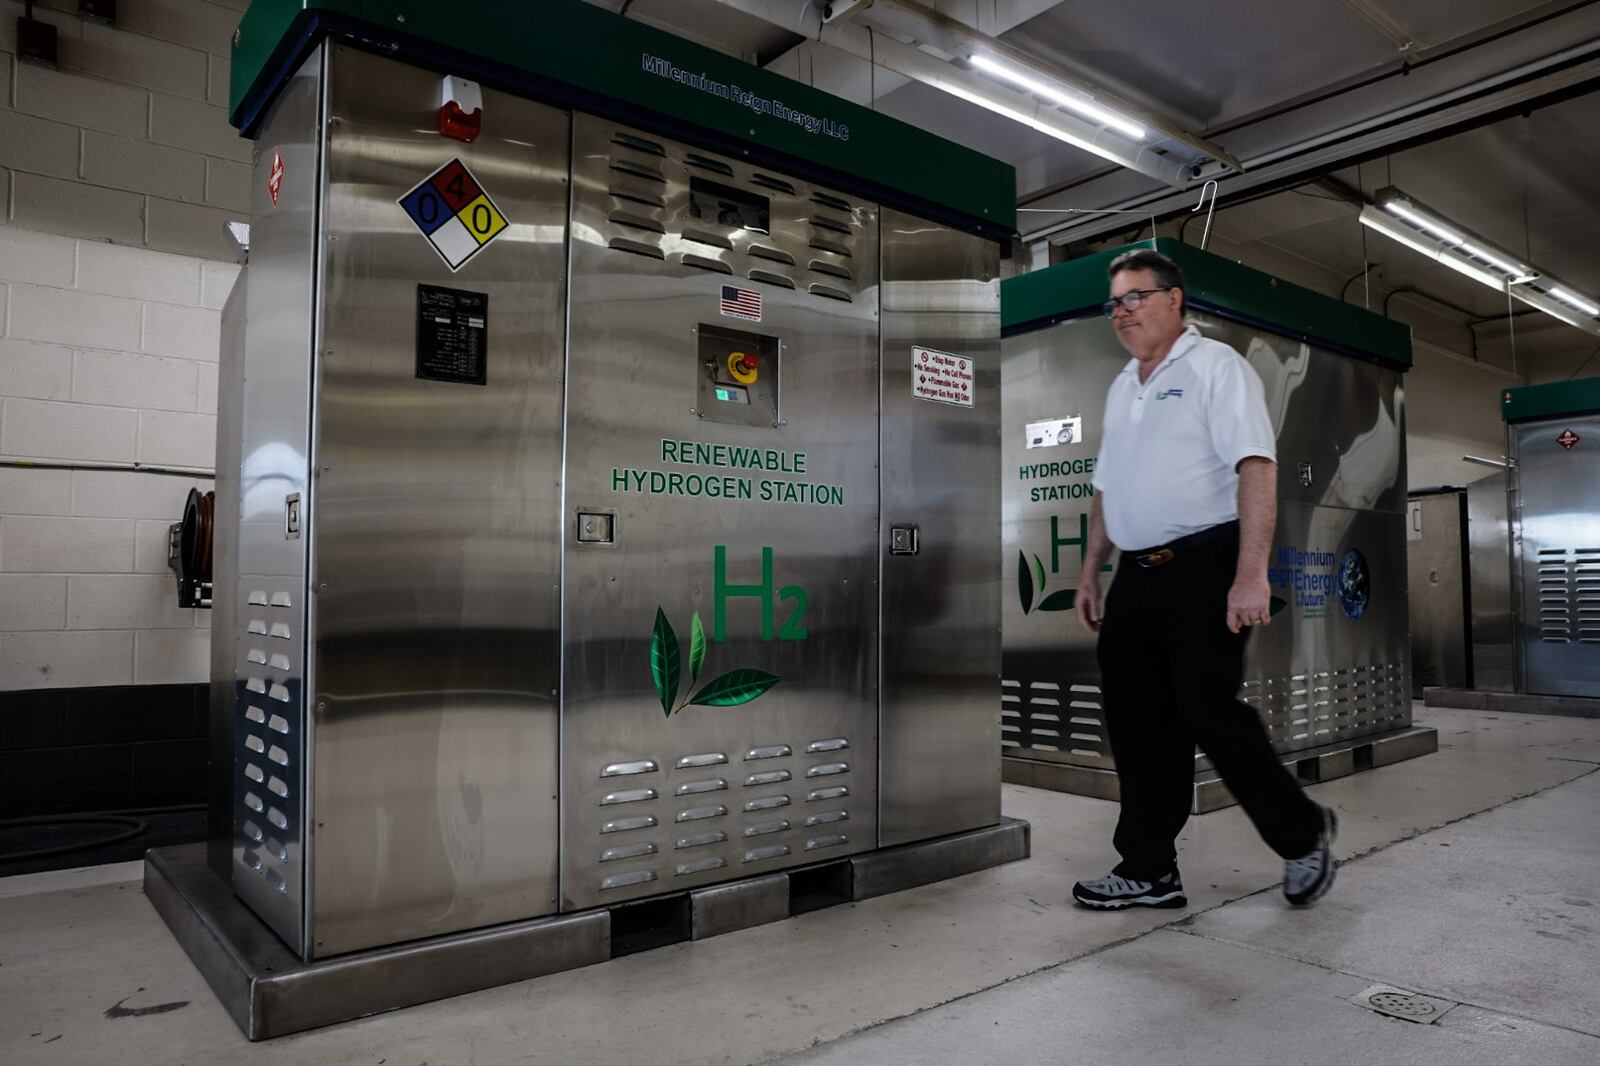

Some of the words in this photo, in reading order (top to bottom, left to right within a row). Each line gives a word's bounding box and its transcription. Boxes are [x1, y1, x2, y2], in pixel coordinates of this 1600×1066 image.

[642, 53, 730, 100] Millennium
[730, 84, 772, 115] Reign
[773, 99, 822, 135] Energy
[823, 117, 850, 141] LLC
[446, 174, 468, 201] 4
[417, 192, 439, 224] 0
[472, 204, 492, 235] 0
[924, 364, 940, 376] Smoking
[920, 386, 938, 397] Hydrogen
[952, 380, 960, 389] Gas
[661, 439, 807, 474] RENEWABLE
[1019, 457, 1098, 480] HYDROGE
[611, 467, 752, 500] HYDROGEN
[759, 479, 844, 506] STATION
[1031, 483, 1094, 502] STATION
[1277, 545, 1335, 566] Millennium
[714, 545, 809, 642] H2
[1294, 568, 1338, 596] Energy
